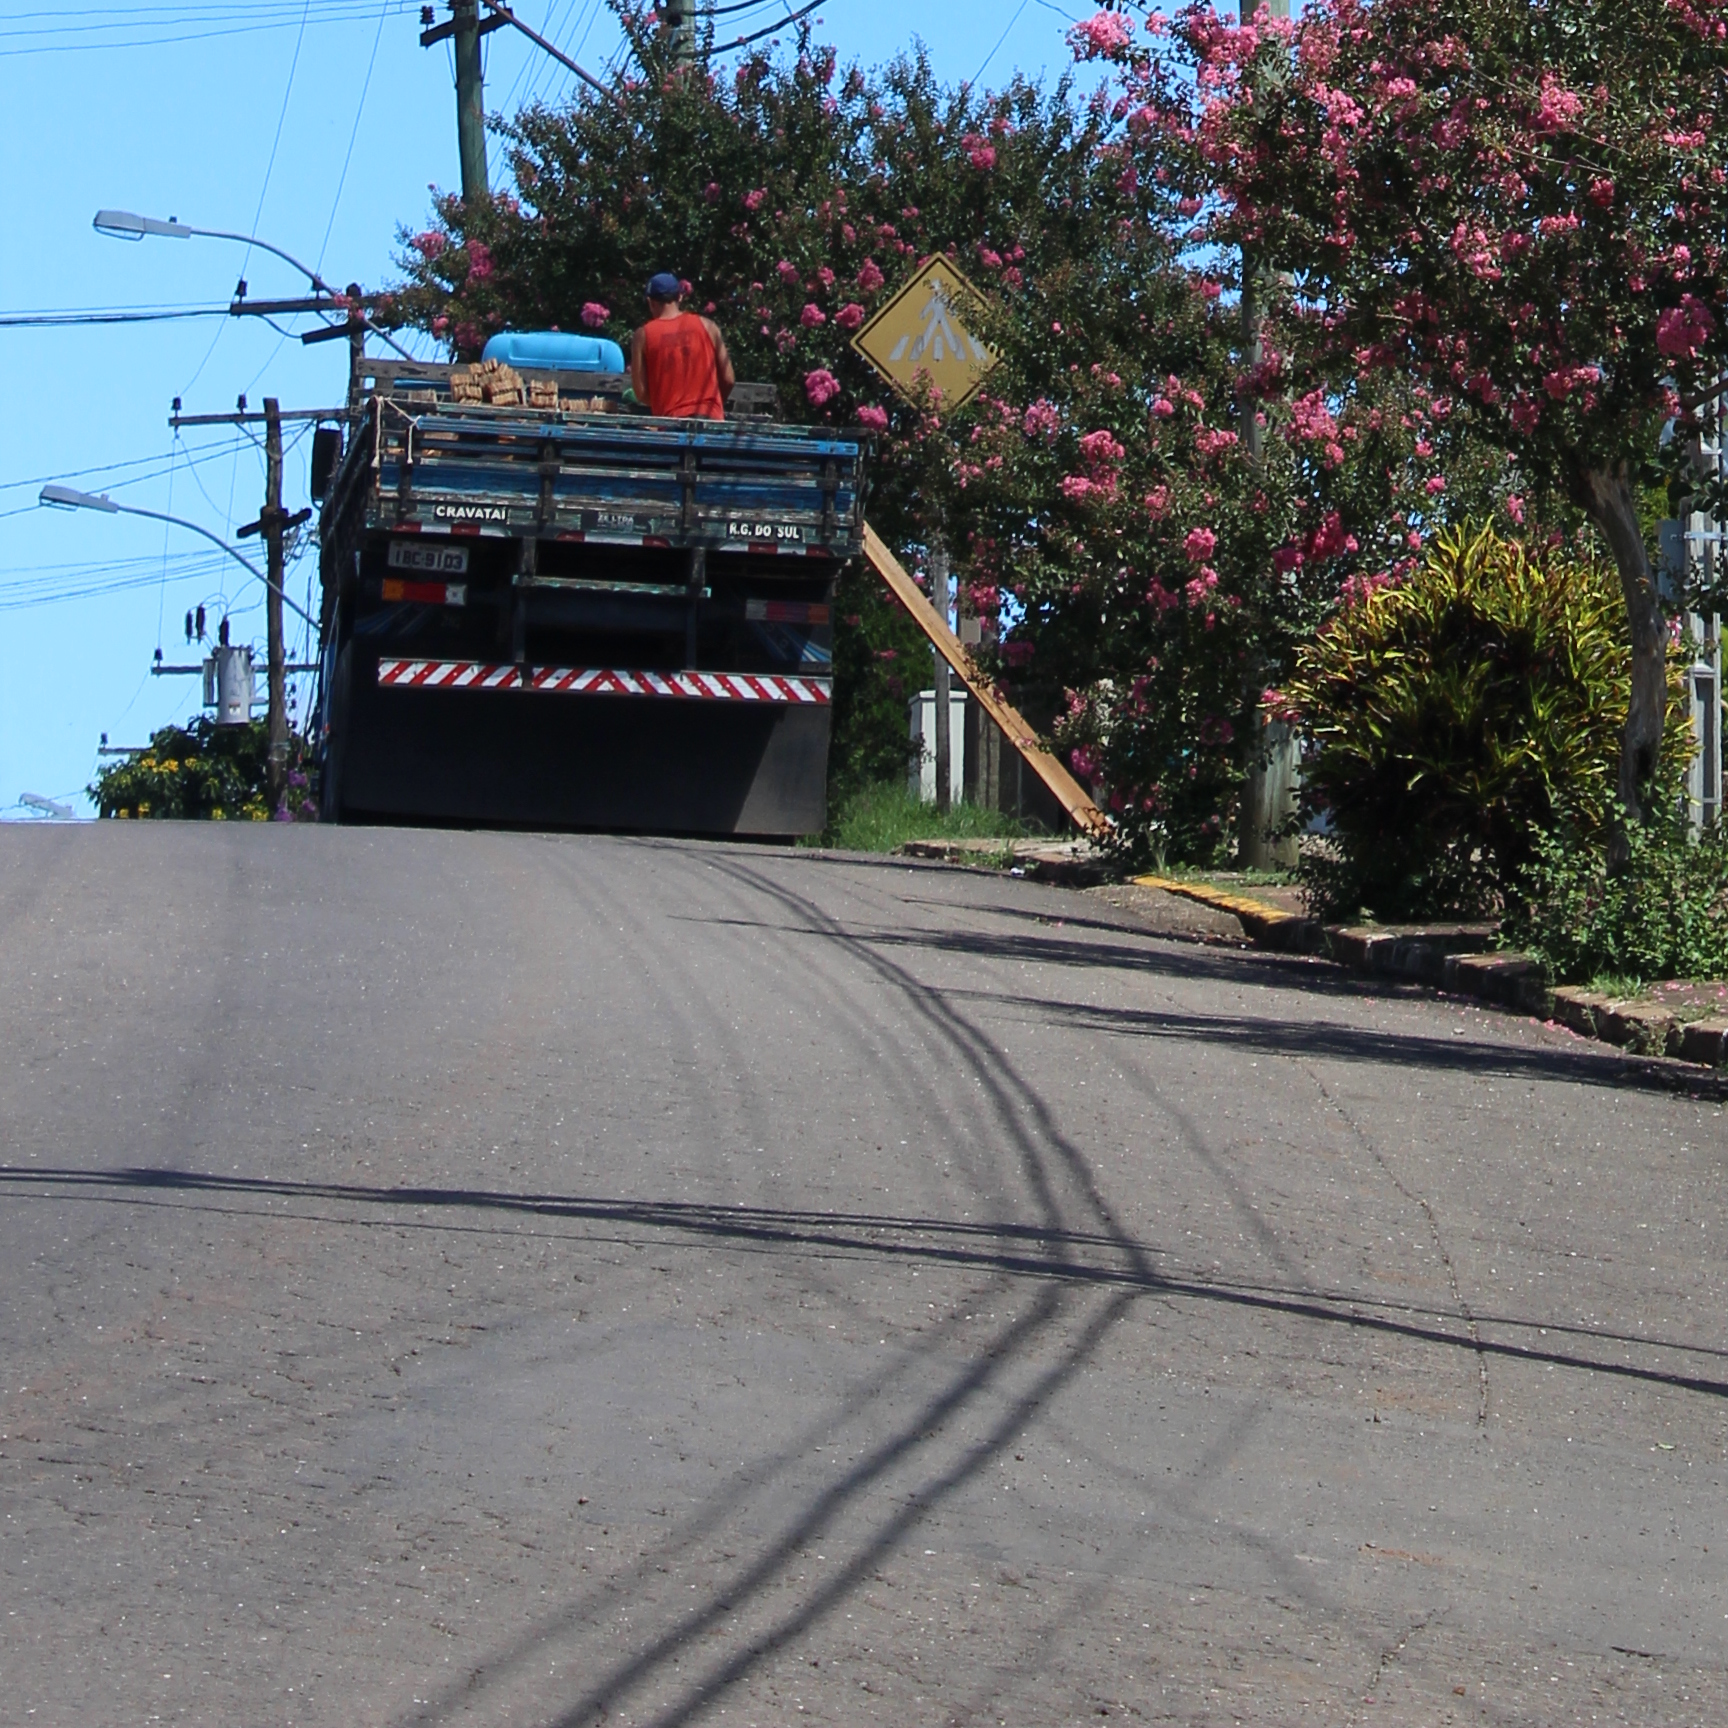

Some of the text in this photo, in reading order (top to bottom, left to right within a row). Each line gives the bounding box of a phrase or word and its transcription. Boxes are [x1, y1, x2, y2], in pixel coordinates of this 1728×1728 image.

[729, 523, 800, 539] R.G. DO SUL
